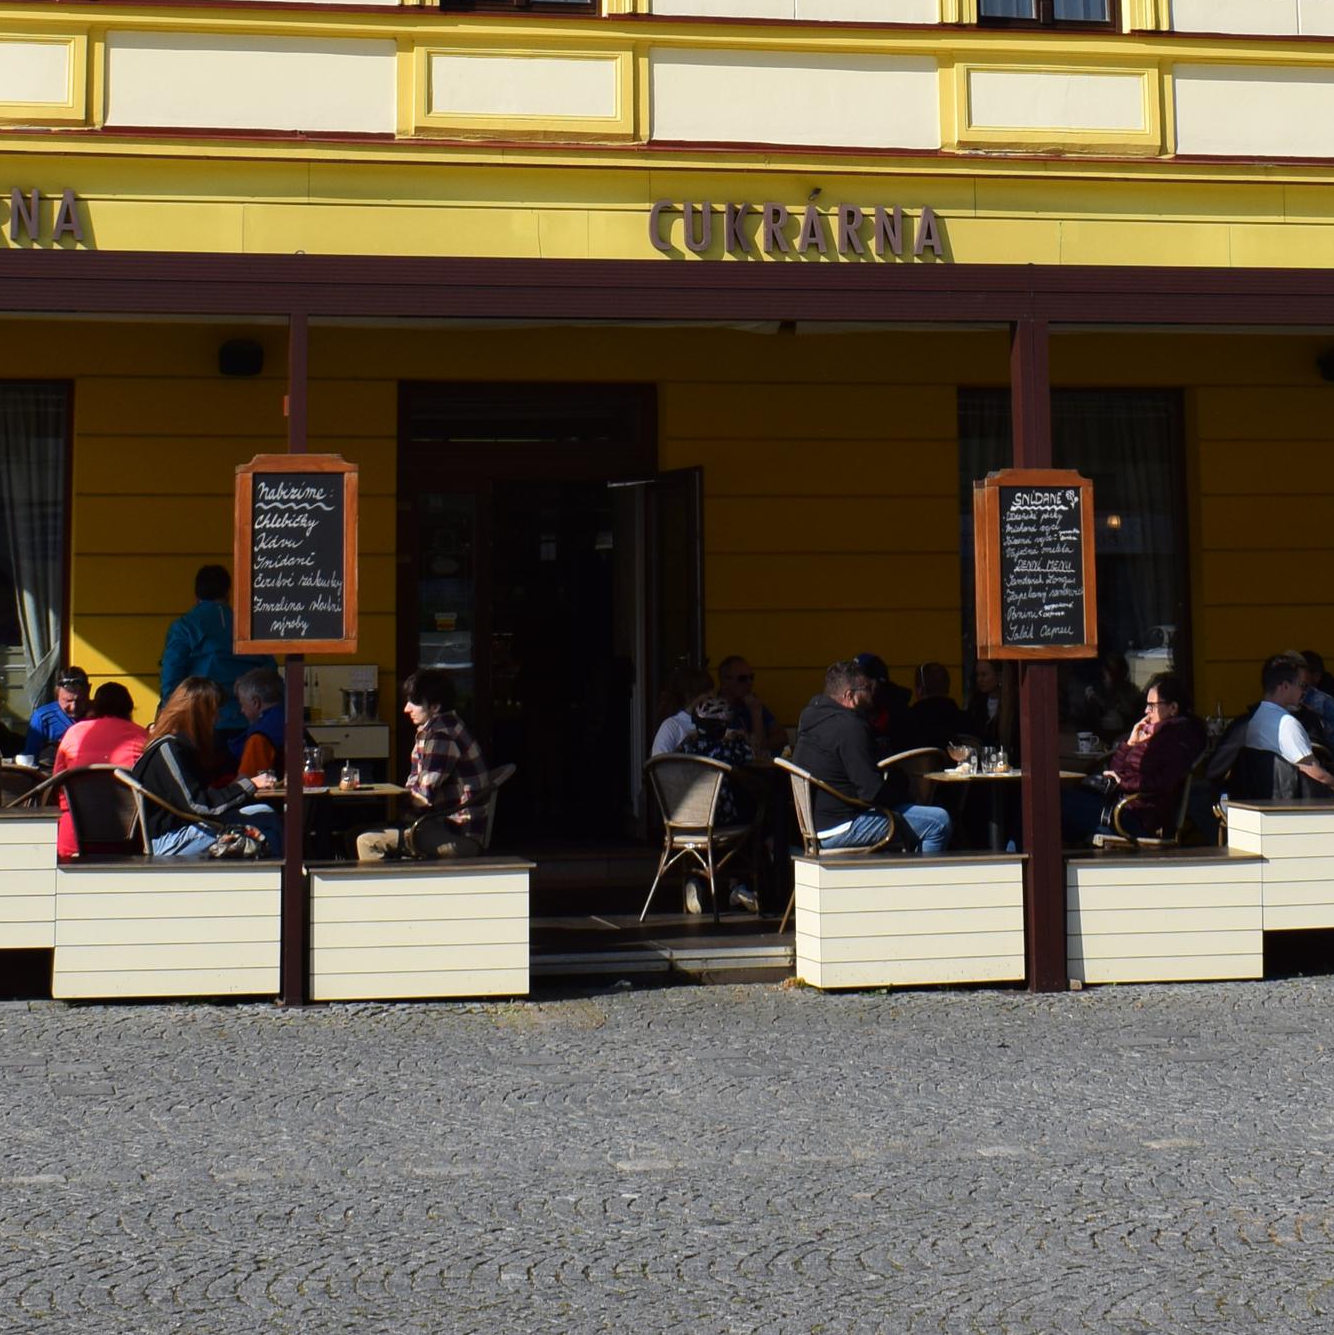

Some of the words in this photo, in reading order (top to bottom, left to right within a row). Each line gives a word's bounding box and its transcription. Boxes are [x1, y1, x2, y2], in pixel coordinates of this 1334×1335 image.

[649, 188, 943, 256] CUKRÁRNA
[254, 512, 319, 537] Chlebíčky
[254, 532, 304, 552] Kávu
[254, 595, 305, 613] Zmrzlina
[270, 615, 309, 636] výroby
